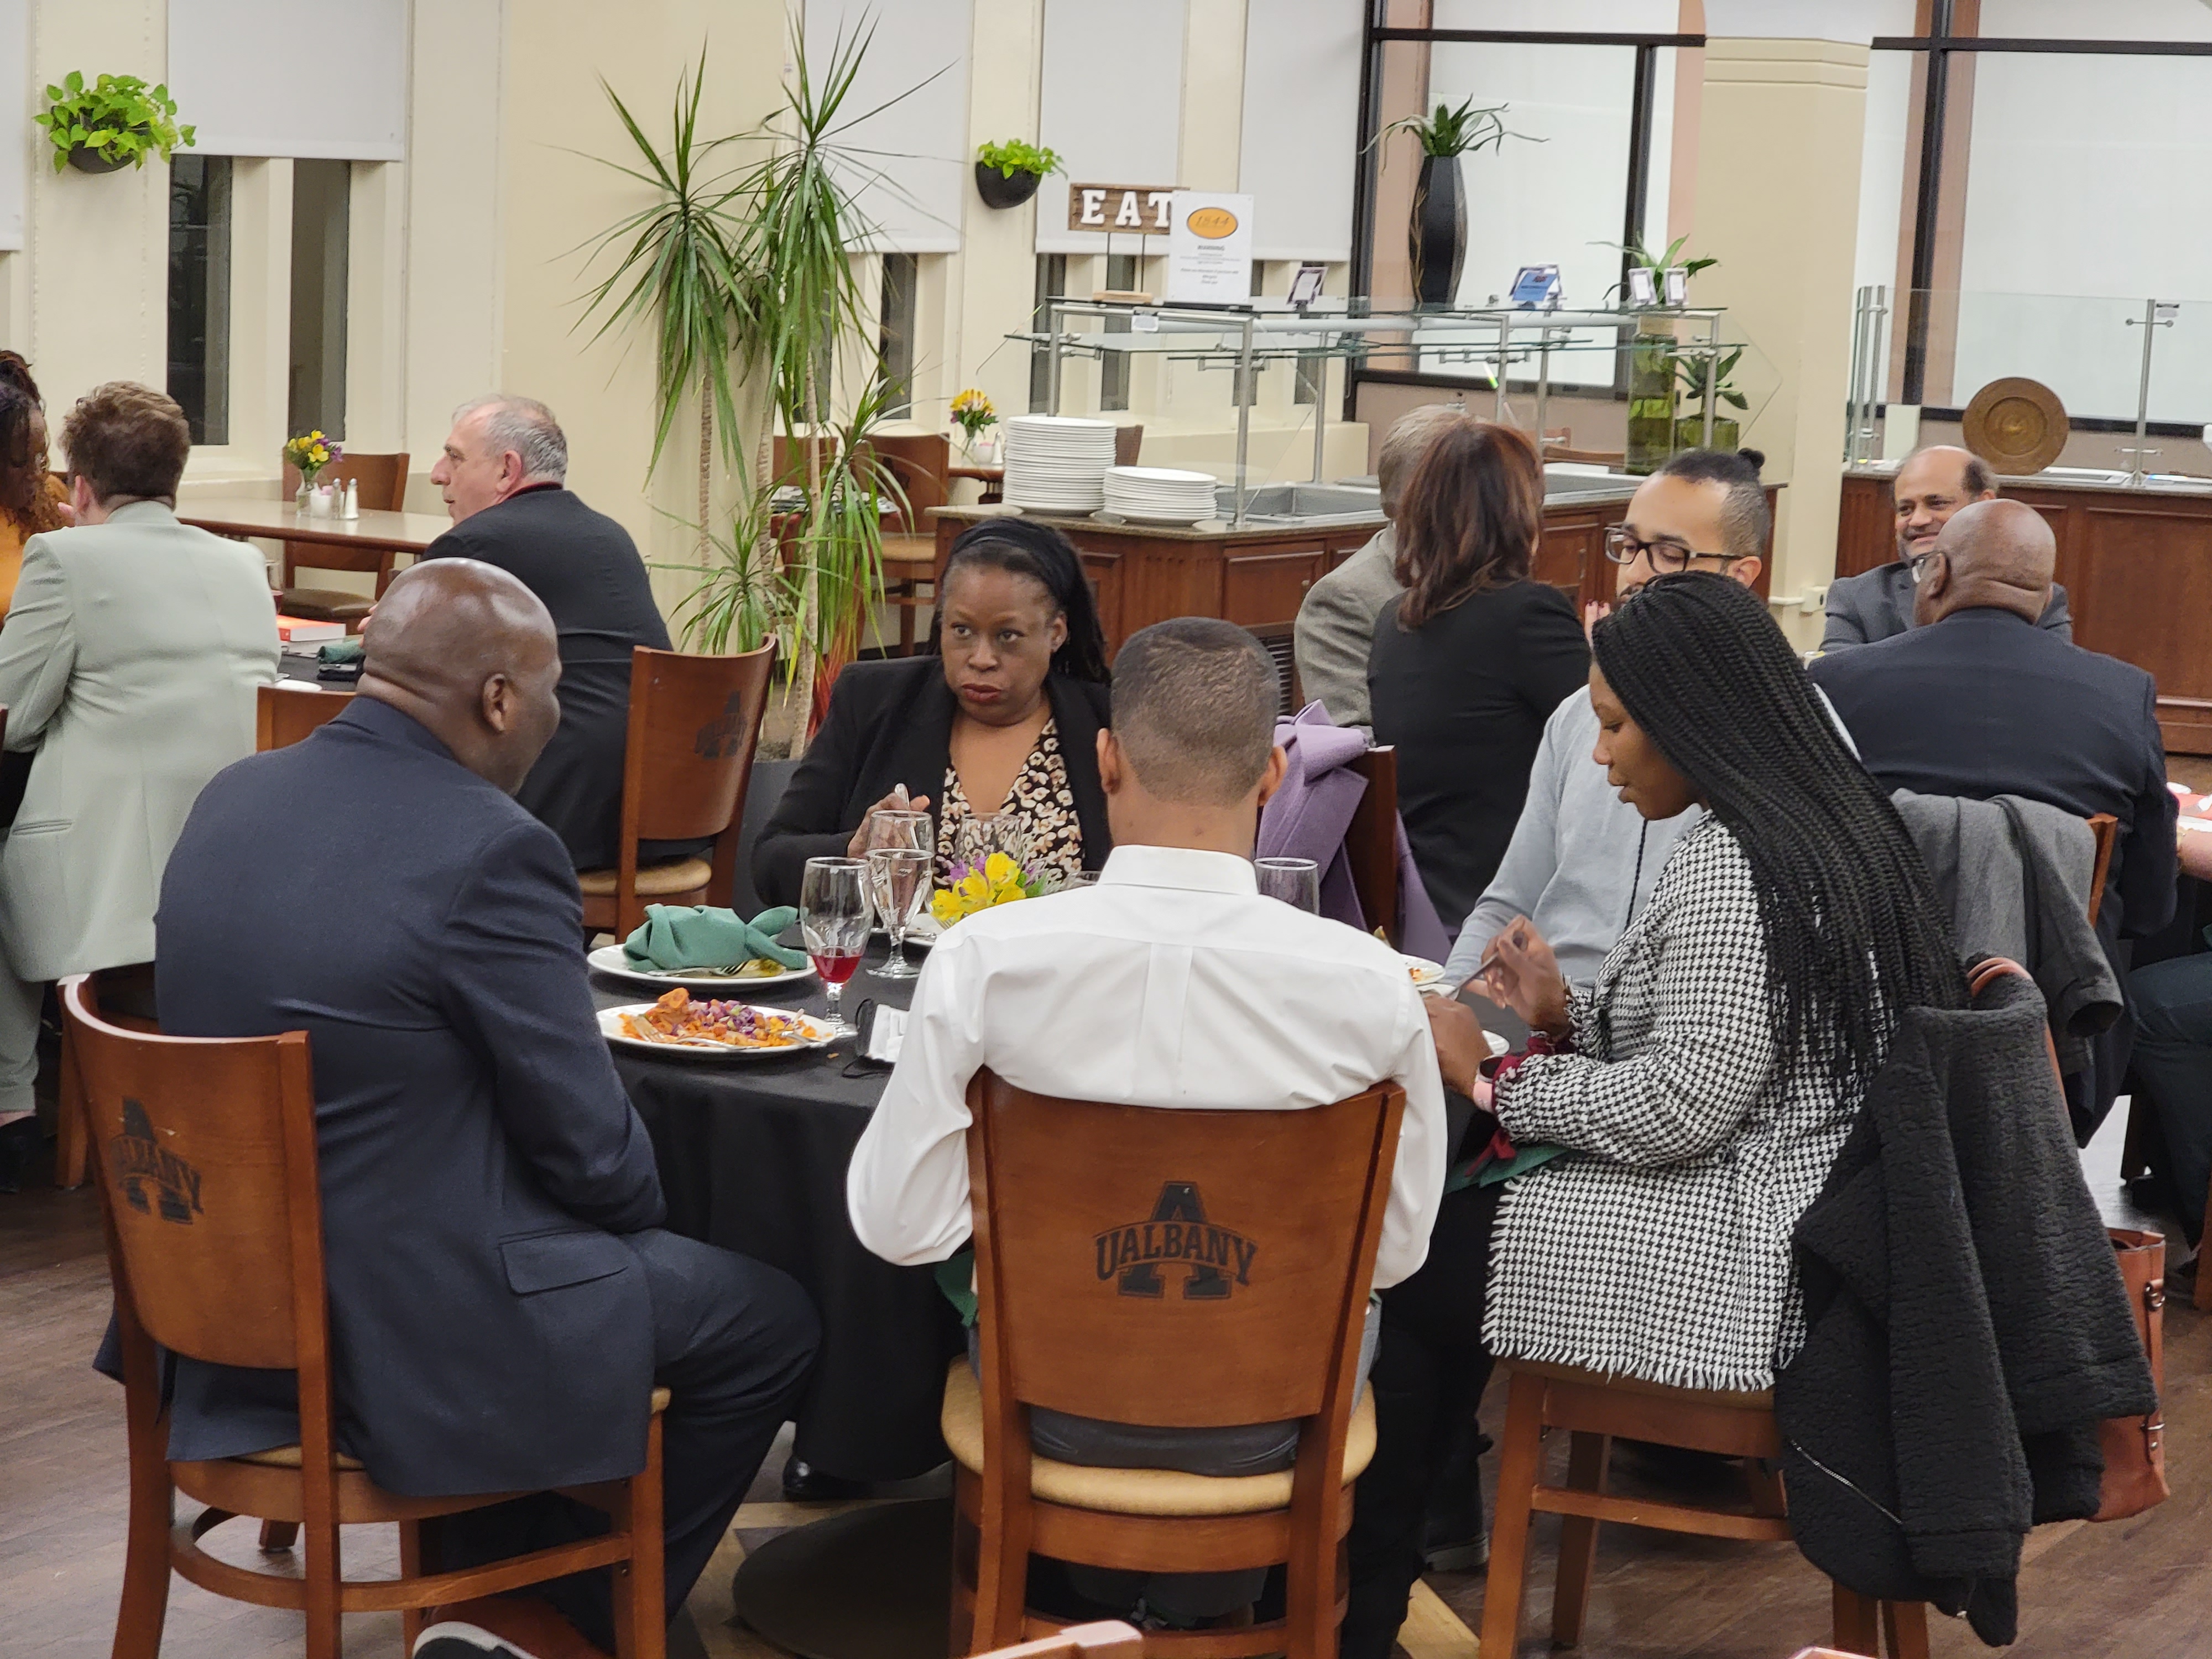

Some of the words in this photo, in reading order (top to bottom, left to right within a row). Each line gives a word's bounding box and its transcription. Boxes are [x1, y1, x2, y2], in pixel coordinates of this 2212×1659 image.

[1081, 189, 1172, 227] EAT
[1196, 216, 1229, 226] 1844
[1096, 1223, 1256, 1287] UALBANY
